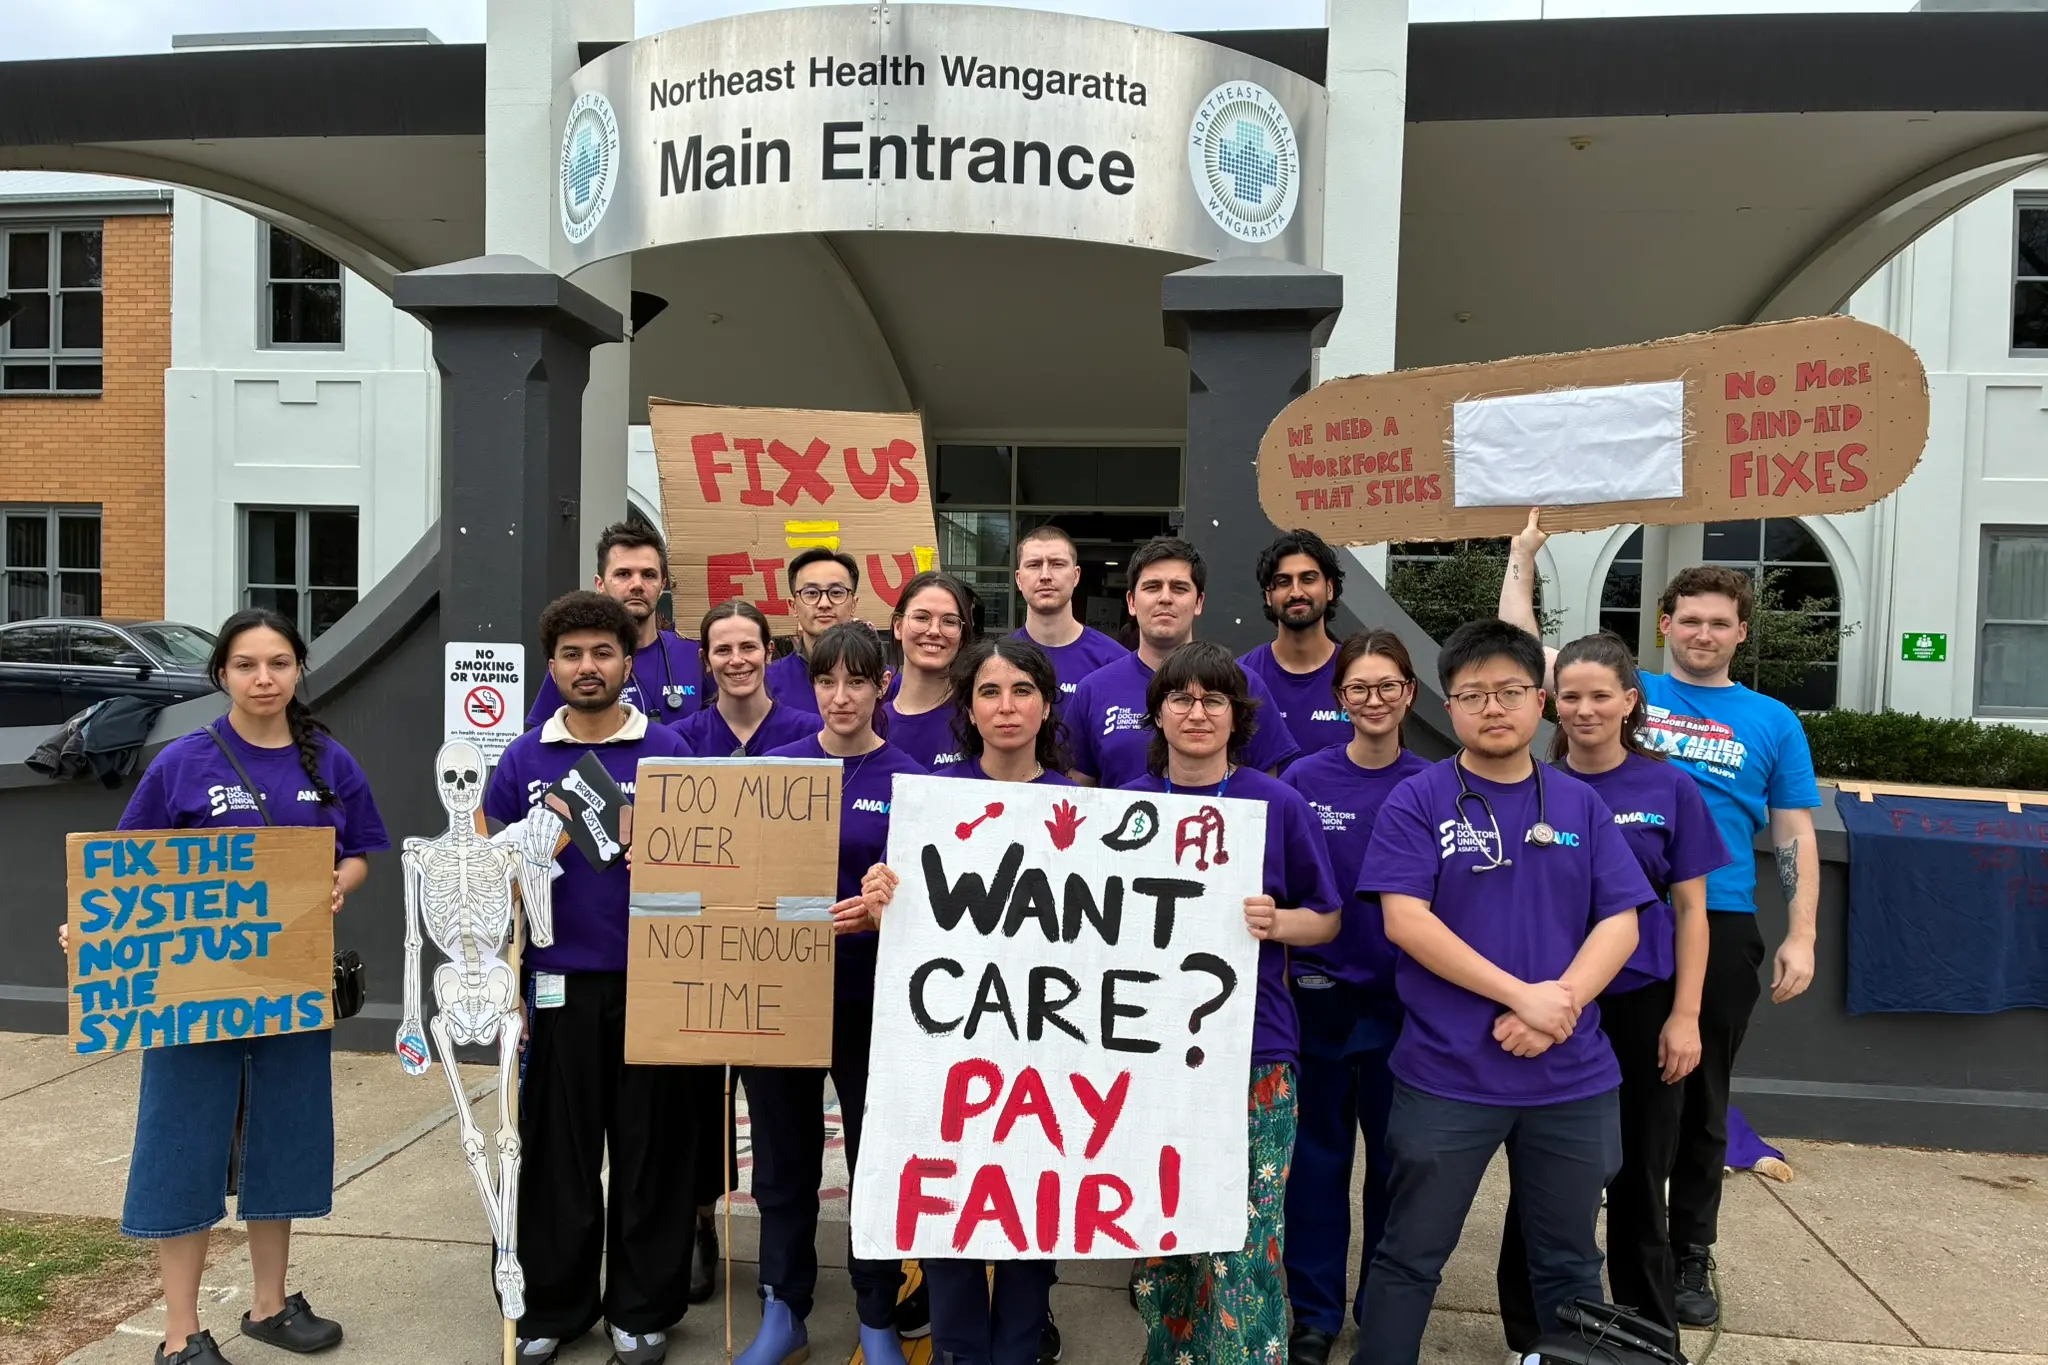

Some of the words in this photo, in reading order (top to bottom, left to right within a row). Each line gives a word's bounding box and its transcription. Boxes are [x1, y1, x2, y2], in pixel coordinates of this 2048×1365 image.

[651, 60, 796, 111] Northeast
[809, 54, 926, 88] Health
[941, 55, 1149, 107] Wangaratta
[593, 95, 617, 150] HEALTH
[1193, 86, 1262, 147] NORTHEAST
[1268, 102, 1297, 174] HEALTH
[660, 128, 791, 197] Main
[822, 121, 1136, 196] Entrance
[565, 197, 607, 239] WANGARATTA
[1208, 196, 1286, 238] WANGARATTA
[1288, 424, 1313, 447] WE
[1326, 419, 1373, 441] NEED
[1384, 417, 1399, 436] A
[1726, 405, 1863, 444] BAND-AID
[691, 432, 835, 507] FIX
[843, 439, 920, 504] US
[1289, 448, 1413, 479] WORKFORCE
[1728, 443, 1870, 498] FIXES
[1297, 486, 1353, 511] THAT
[1367, 473, 1442, 506] STICKS
[706, 551, 790, 616] FI
[455, 660, 515, 672] SMOKING
[475, 649, 494, 660] NO
[450, 672, 468, 682] OR
[472, 672, 519, 684] VAPING
[1648, 716, 1661, 724] NO
[1661, 718, 1686, 728] MORE
[1686, 721, 1710, 732] BAND
[1683, 746, 1743, 768] HEALTH
[1685, 735, 1746, 756] ALLIED
[224, 785, 242, 794] THE
[1707, 765, 1736, 780] VAHPA
[226, 790, 266, 801] DOCTS
[228, 797, 256, 806] UNION
[230, 803, 250, 811] ASMOF
[574, 780, 604, 810] BROKEN
[648, 774, 717, 814] TOO
[734, 775, 831, 821] MUCH
[583, 809, 609, 848] SYSTEM
[1614, 811, 1666, 826] AMAVIC
[84, 838, 160, 879] FIX
[167, 833, 256, 875] THE
[648, 826, 734, 864] OVER
[1457, 838, 1487, 846] UNION
[80, 880, 268, 934] SYSTEM
[921, 841, 1207, 950] WANT
[78, 930, 172, 977] NOT
[171, 922, 282, 964] JUST
[648, 923, 712, 960] NOT
[720, 926, 832, 963] ENOUGH
[73, 970, 160, 1014] THE
[672, 980, 783, 1030] TIME
[908, 952, 1238, 1069] CARE?
[75, 990, 325, 1055] SYMPTOMS
[940, 1058, 1134, 1160] PAY
[896, 1144, 1182, 1254] FAIR!
